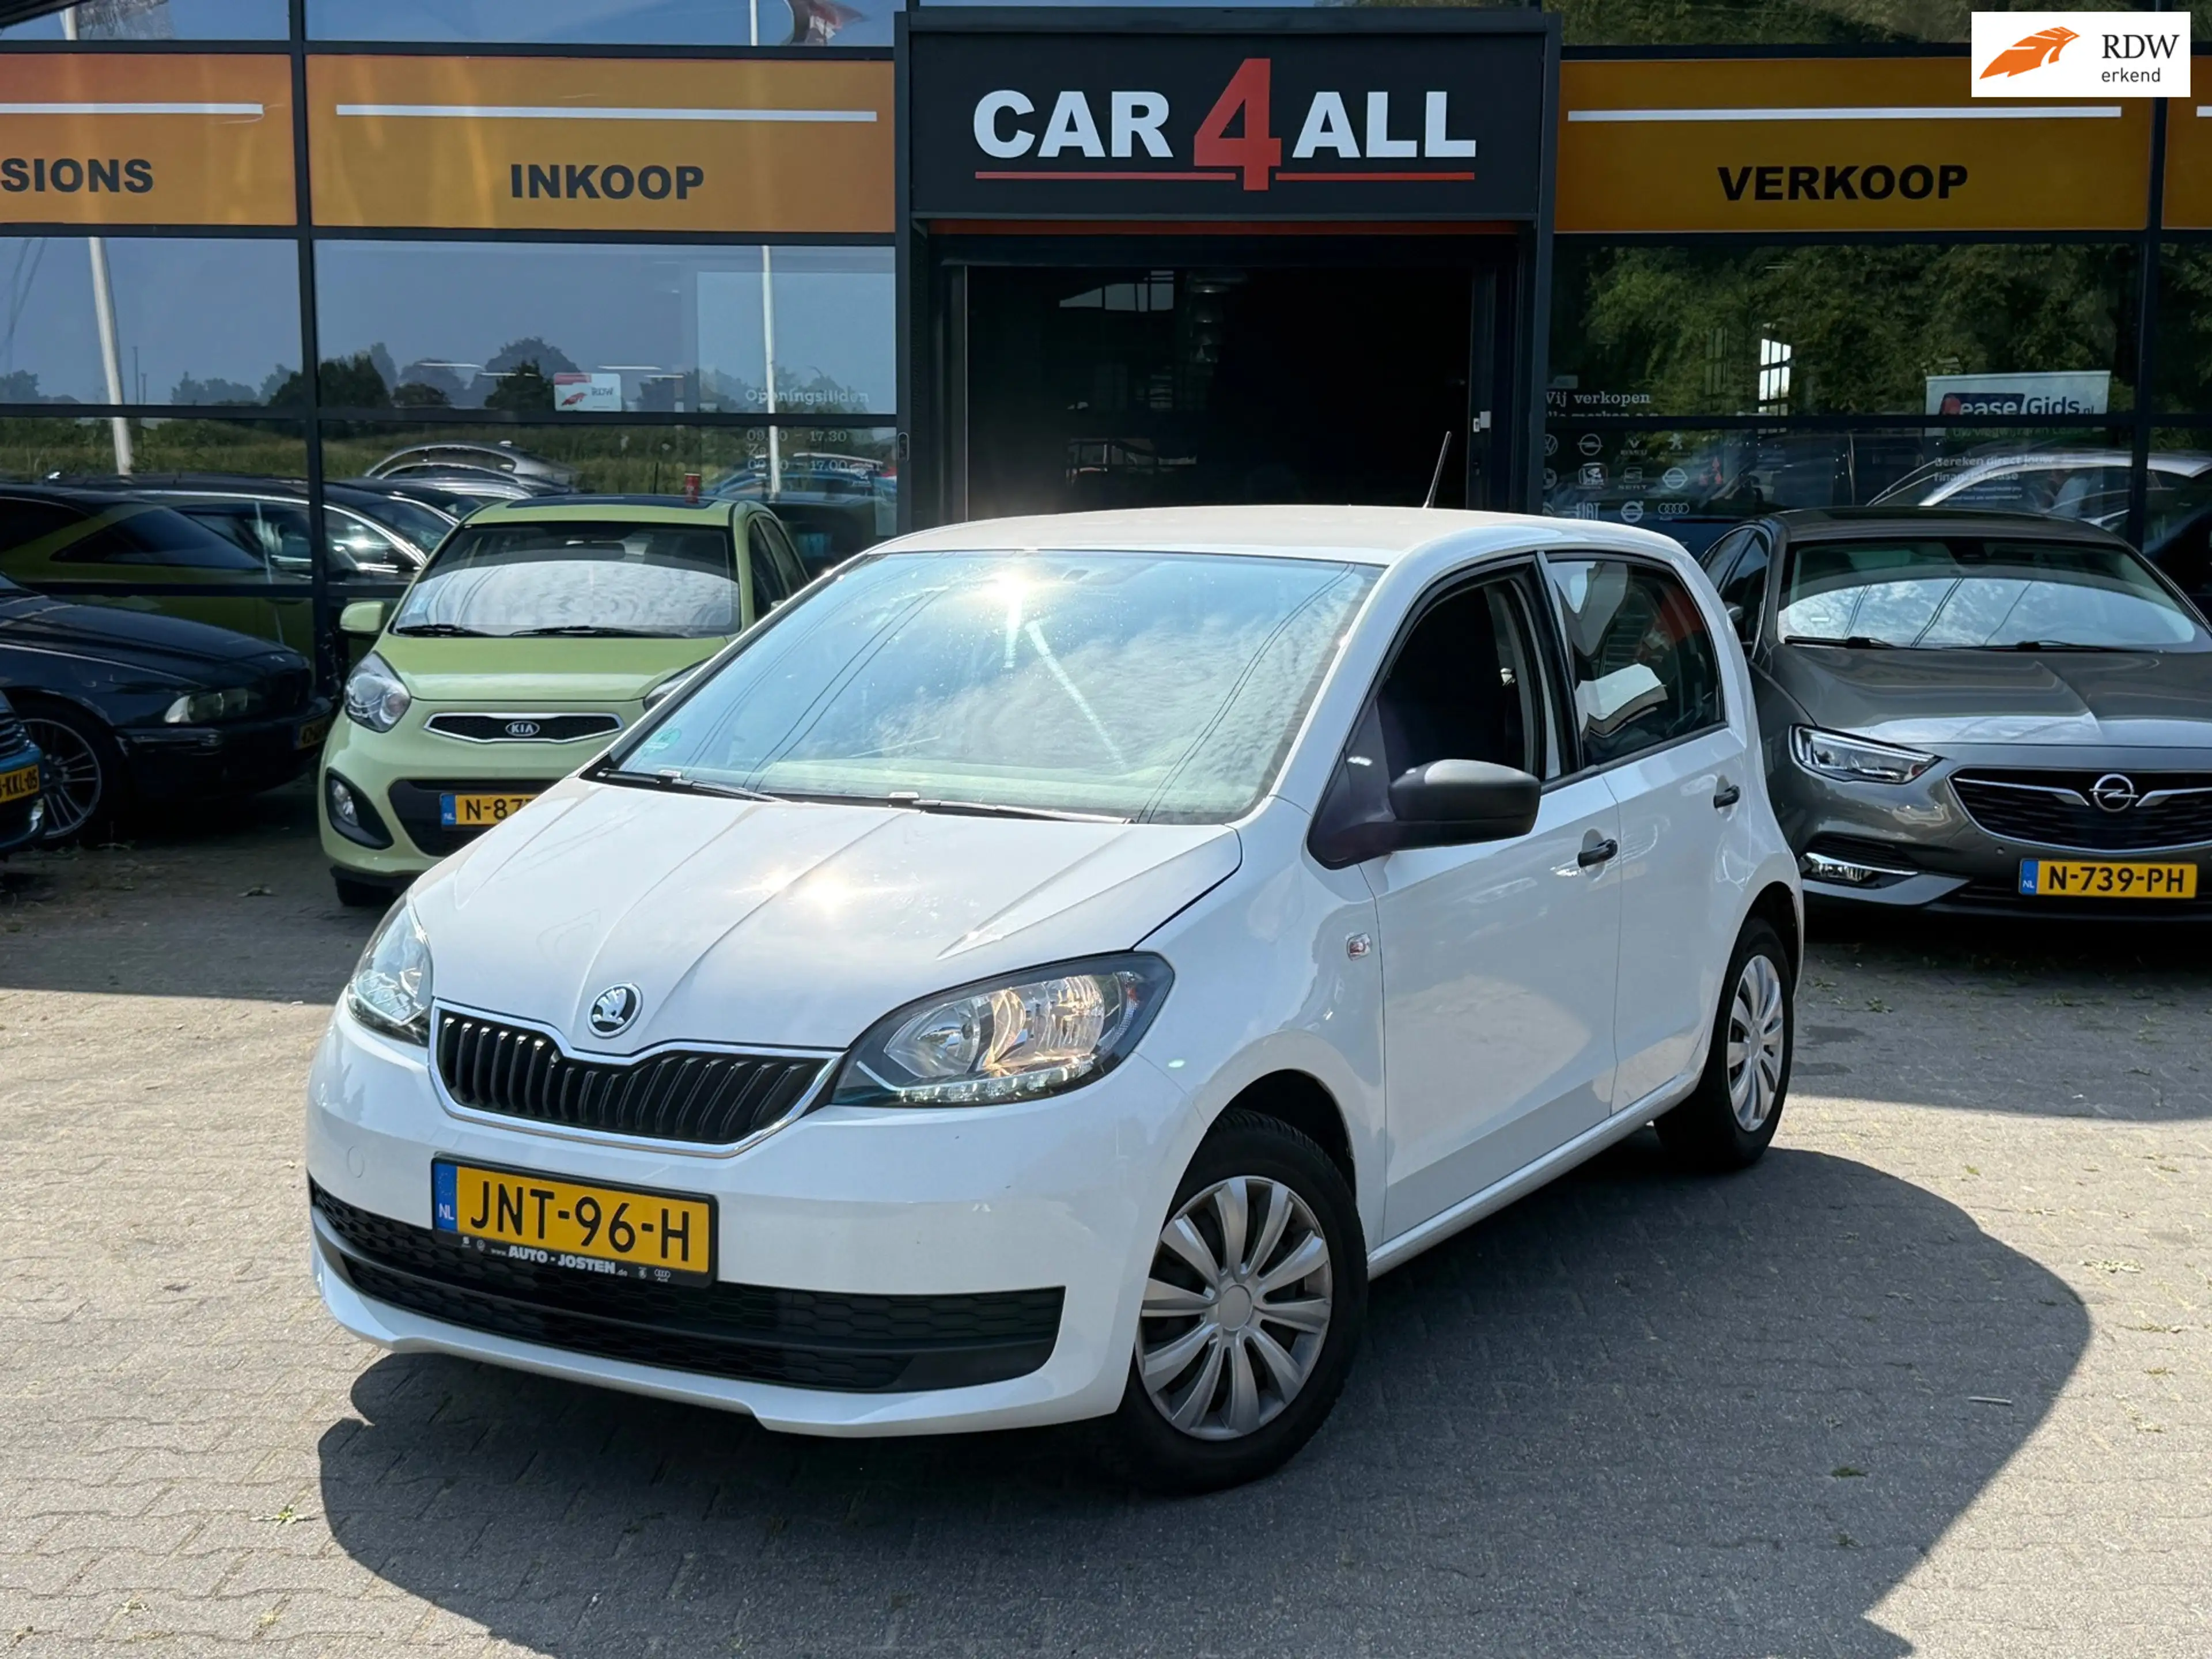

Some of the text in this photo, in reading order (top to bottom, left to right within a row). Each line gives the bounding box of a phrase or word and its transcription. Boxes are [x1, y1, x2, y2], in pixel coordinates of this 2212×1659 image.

[973, 58, 1476, 191] CAR 4 ALL
[1, 158, 154, 193] SIONS
[510, 164, 704, 200] INKOOP
[1718, 165, 1968, 201] VERKOOP
[745, 388, 870, 405] Opningstijden
[1574, 391, 1651, 407] verkopen
[747, 430, 788, 441] 09.0
[810, 430, 847, 442] 17.30
[511, 723, 533, 733] KIA
[465, 798, 535, 821] N-87
[2022, 865, 2185, 893] NL N-739-PH
[438, 1180, 690, 1263] NL JNT-96-H
